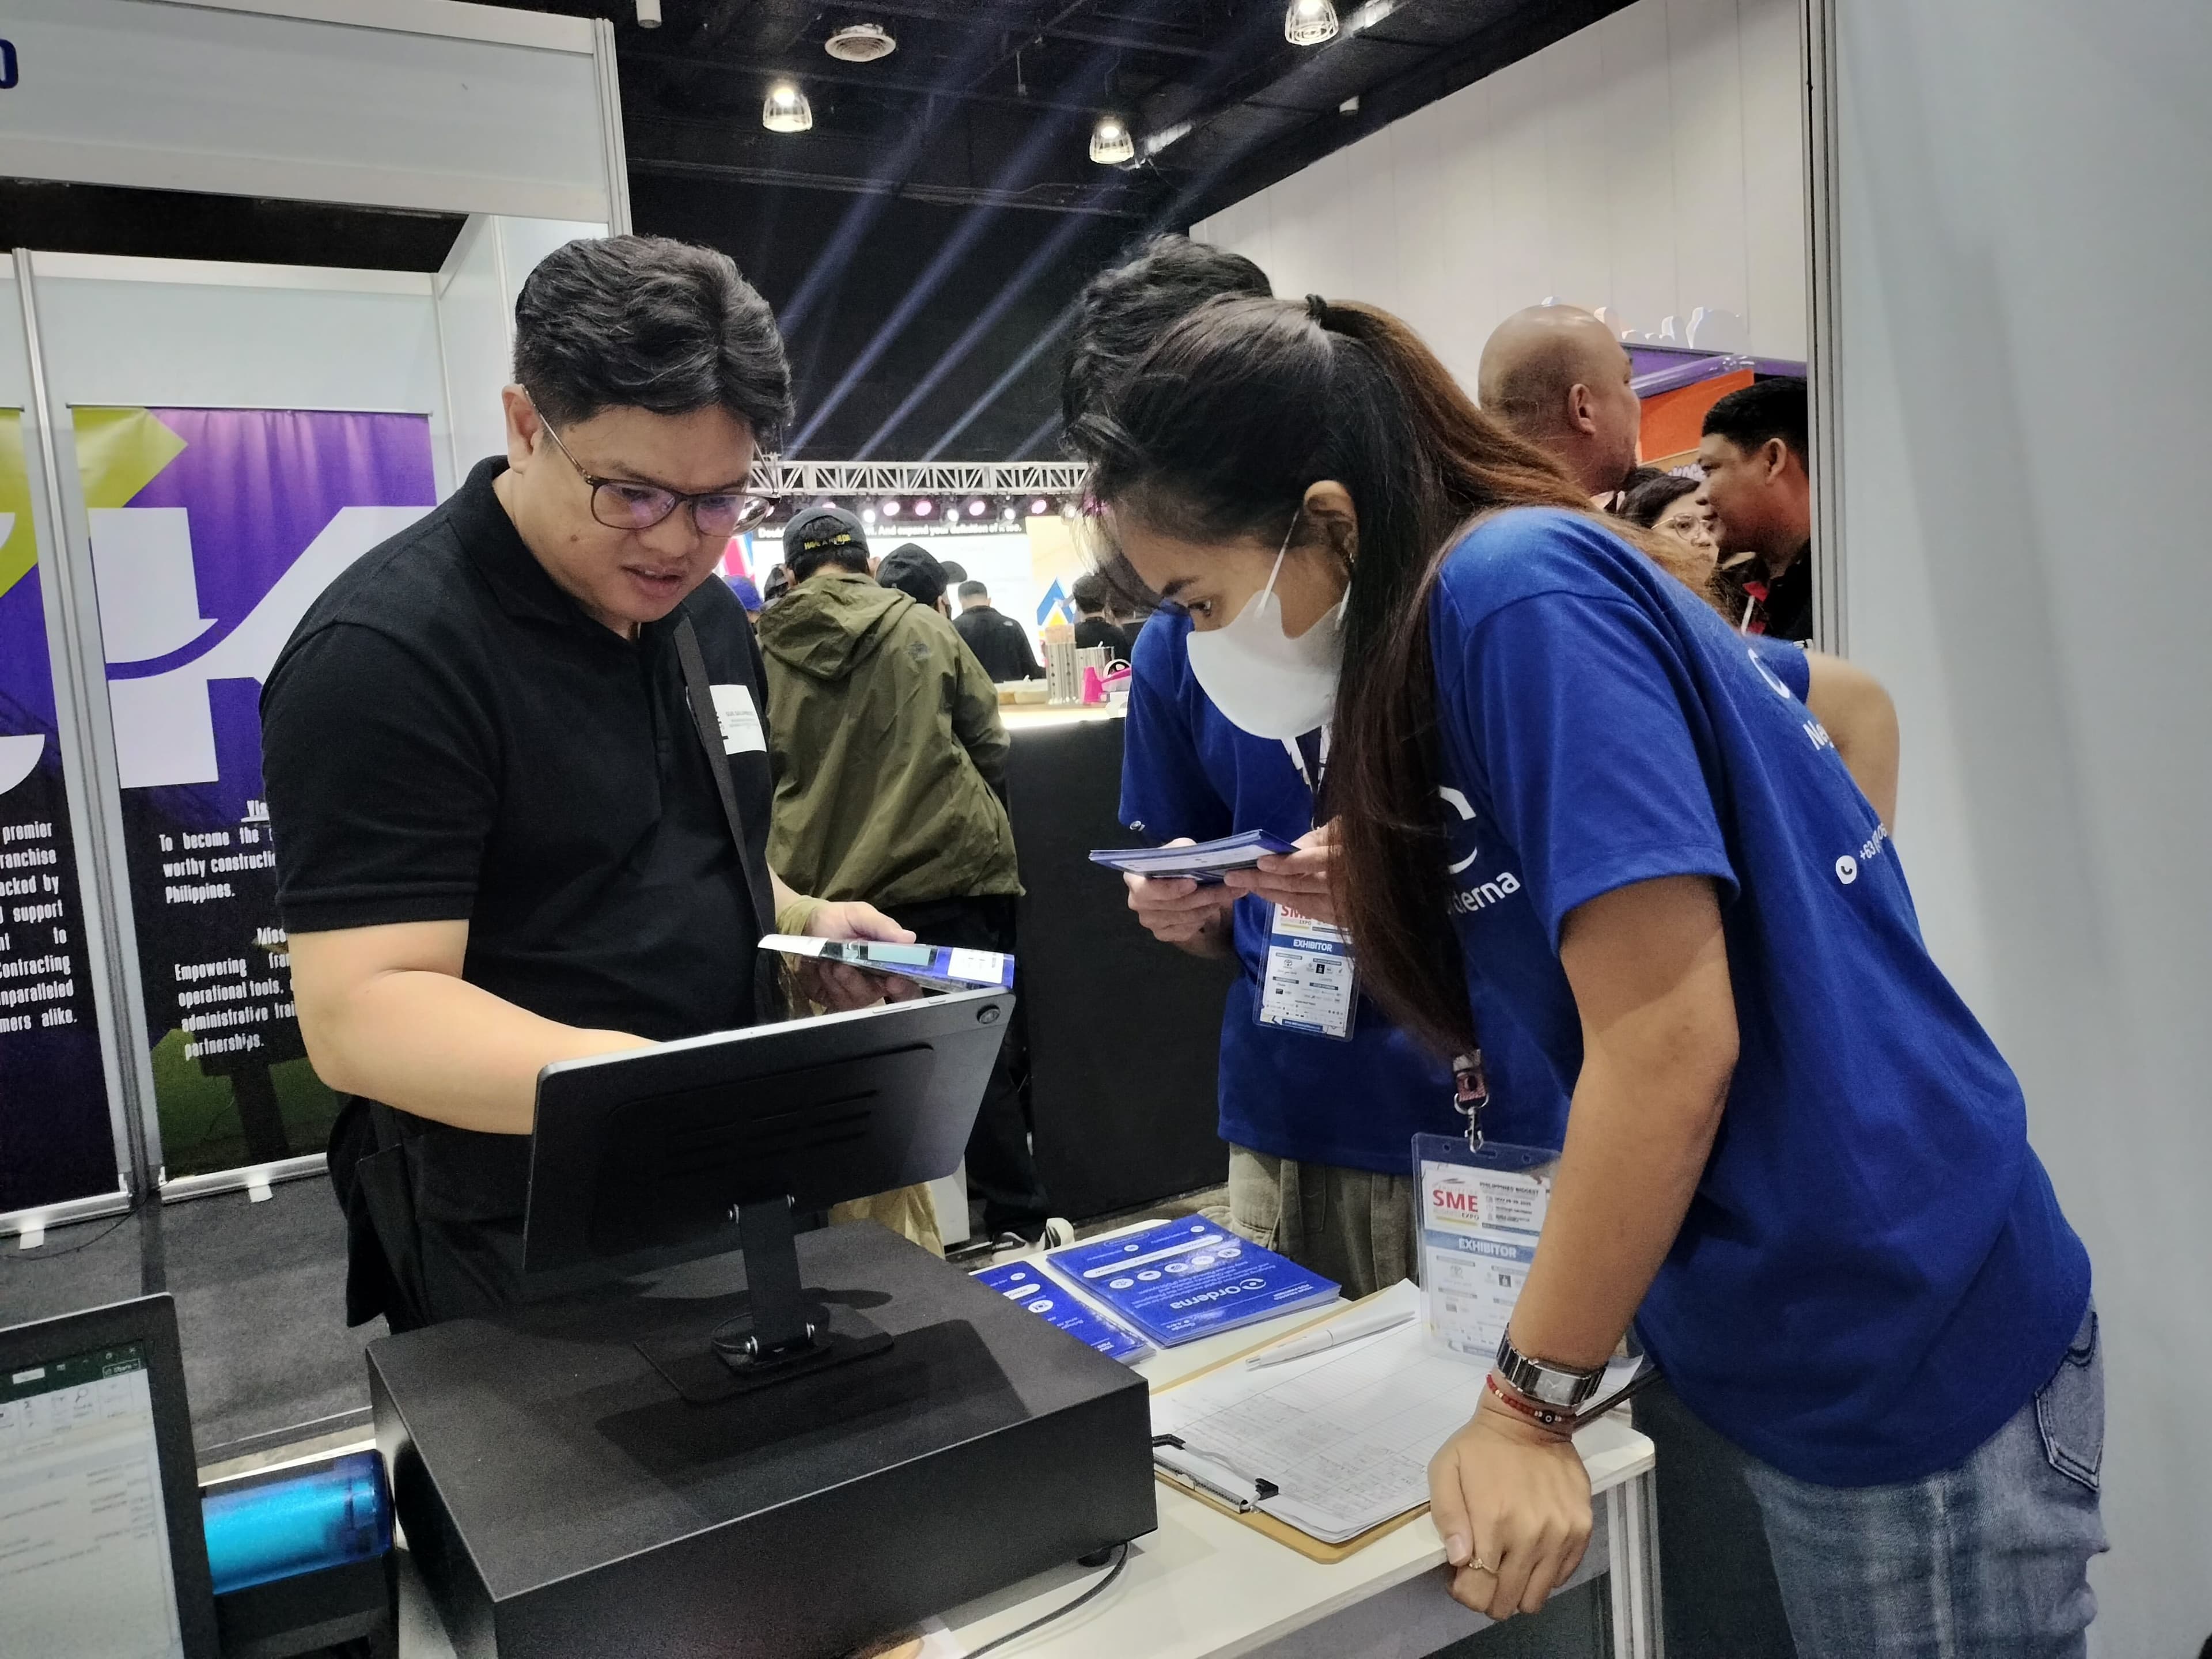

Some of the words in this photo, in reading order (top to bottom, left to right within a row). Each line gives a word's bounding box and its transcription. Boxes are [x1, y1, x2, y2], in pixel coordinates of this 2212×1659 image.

[247, 800, 268, 817] Vis
[2, 821, 52, 845] premier
[159, 834, 173, 852] To
[182, 831, 230, 850] become
[239, 826, 259, 844] the
[0, 847, 57, 870] ranchise
[163, 857, 206, 878] worthy
[0, 874, 37, 897] acked
[43, 873, 59, 895] by
[165, 882, 236, 904] Philippines.
[1448, 872, 1521, 915] derna
[13, 899, 63, 924] support
[52, 926, 67, 944] to
[1293, 938, 1333, 953] EXHIBITOR
[175, 957, 248, 983] Empowering
[0, 978, 74, 1008] nparalleled
[178, 981, 248, 1009] operational
[249, 978, 285, 997] tools.
[0, 1014, 32, 1033] mers
[41, 1007, 78, 1028] alike.
[181, 1006, 269, 1033] administrative
[274, 1001, 296, 1019] trai
[184, 1033, 264, 1061] partnerships.
[1433, 1188, 1478, 1213] SME
[1458, 1238, 1517, 1259] EXHIBITOR
[1170, 1286, 1241, 1309] Orderna
